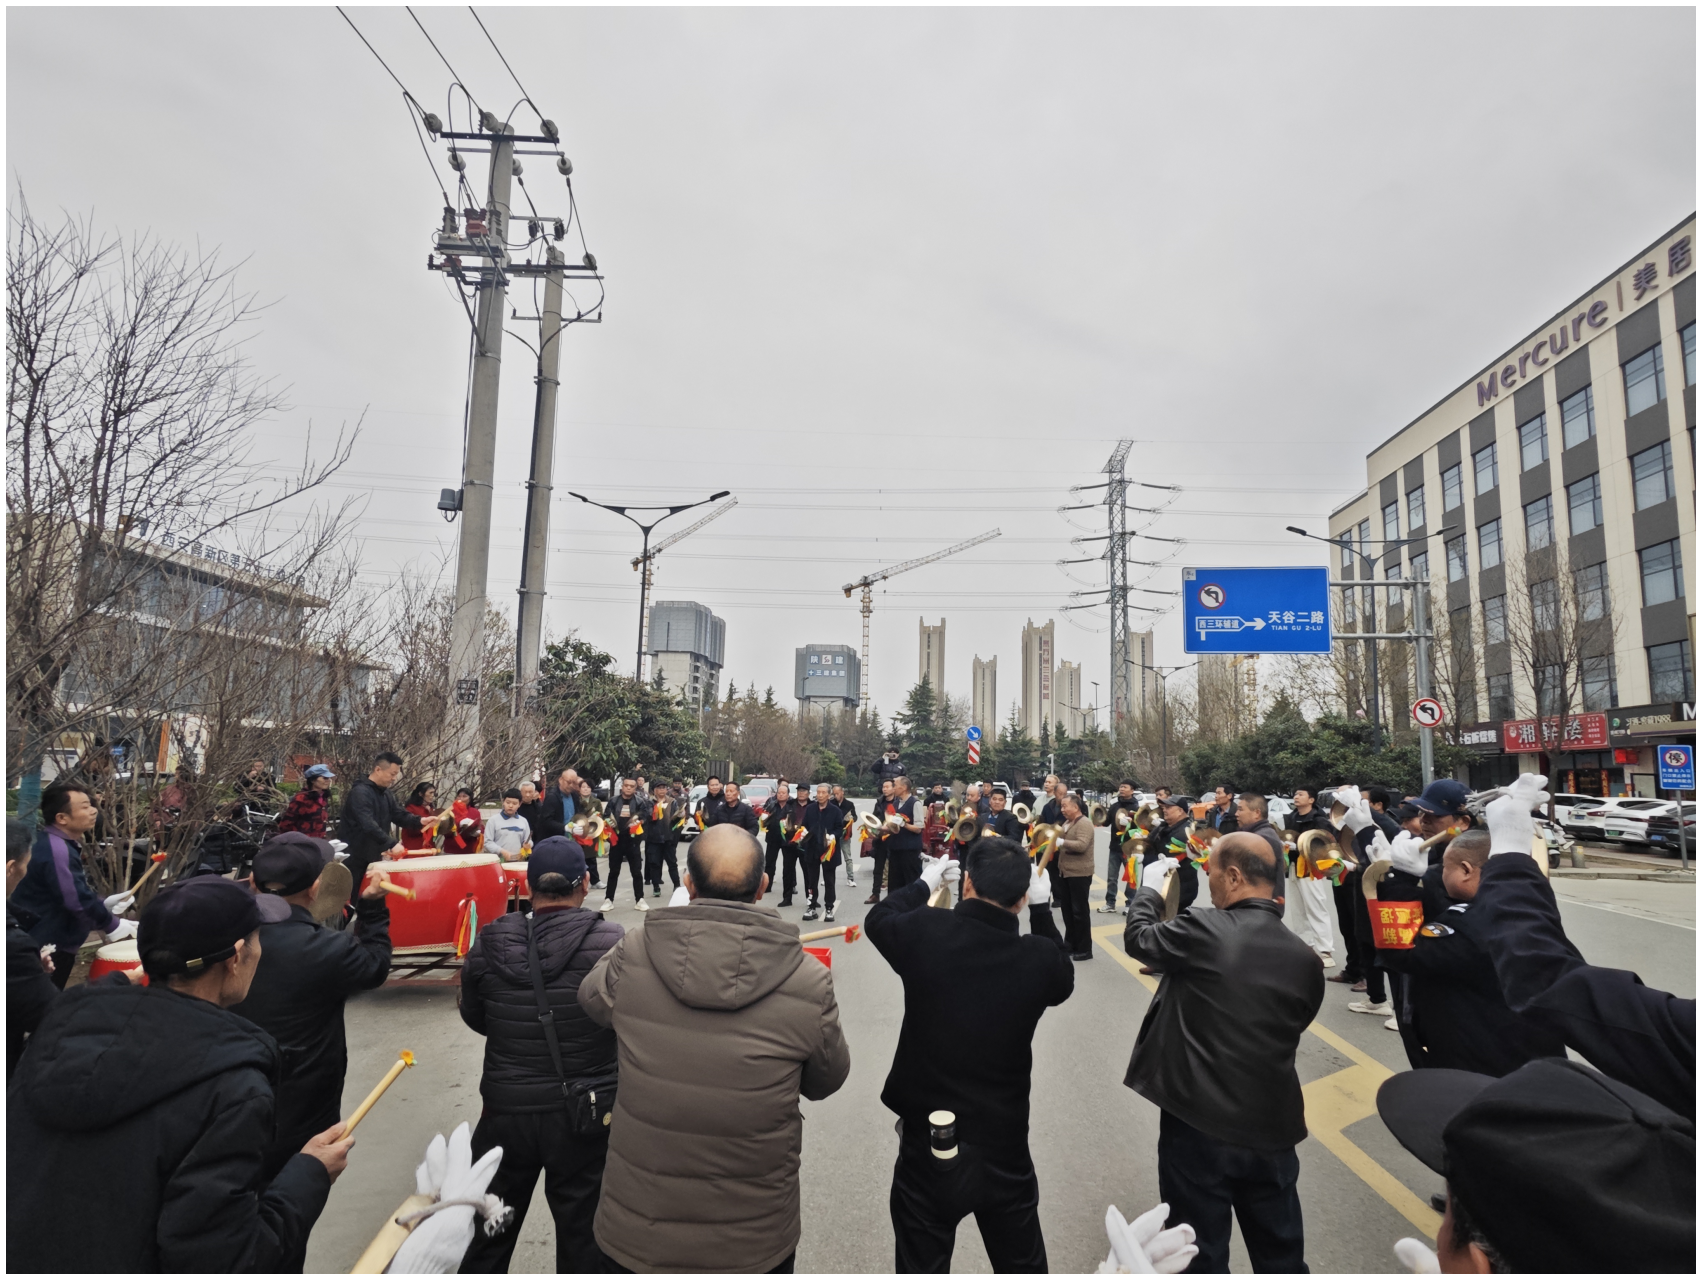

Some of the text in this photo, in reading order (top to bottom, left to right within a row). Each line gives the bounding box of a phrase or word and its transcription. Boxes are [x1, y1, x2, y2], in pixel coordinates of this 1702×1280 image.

[1476, 234, 1692, 407] Mercure 美居
[1268, 611, 1324, 624] 天谷二路
